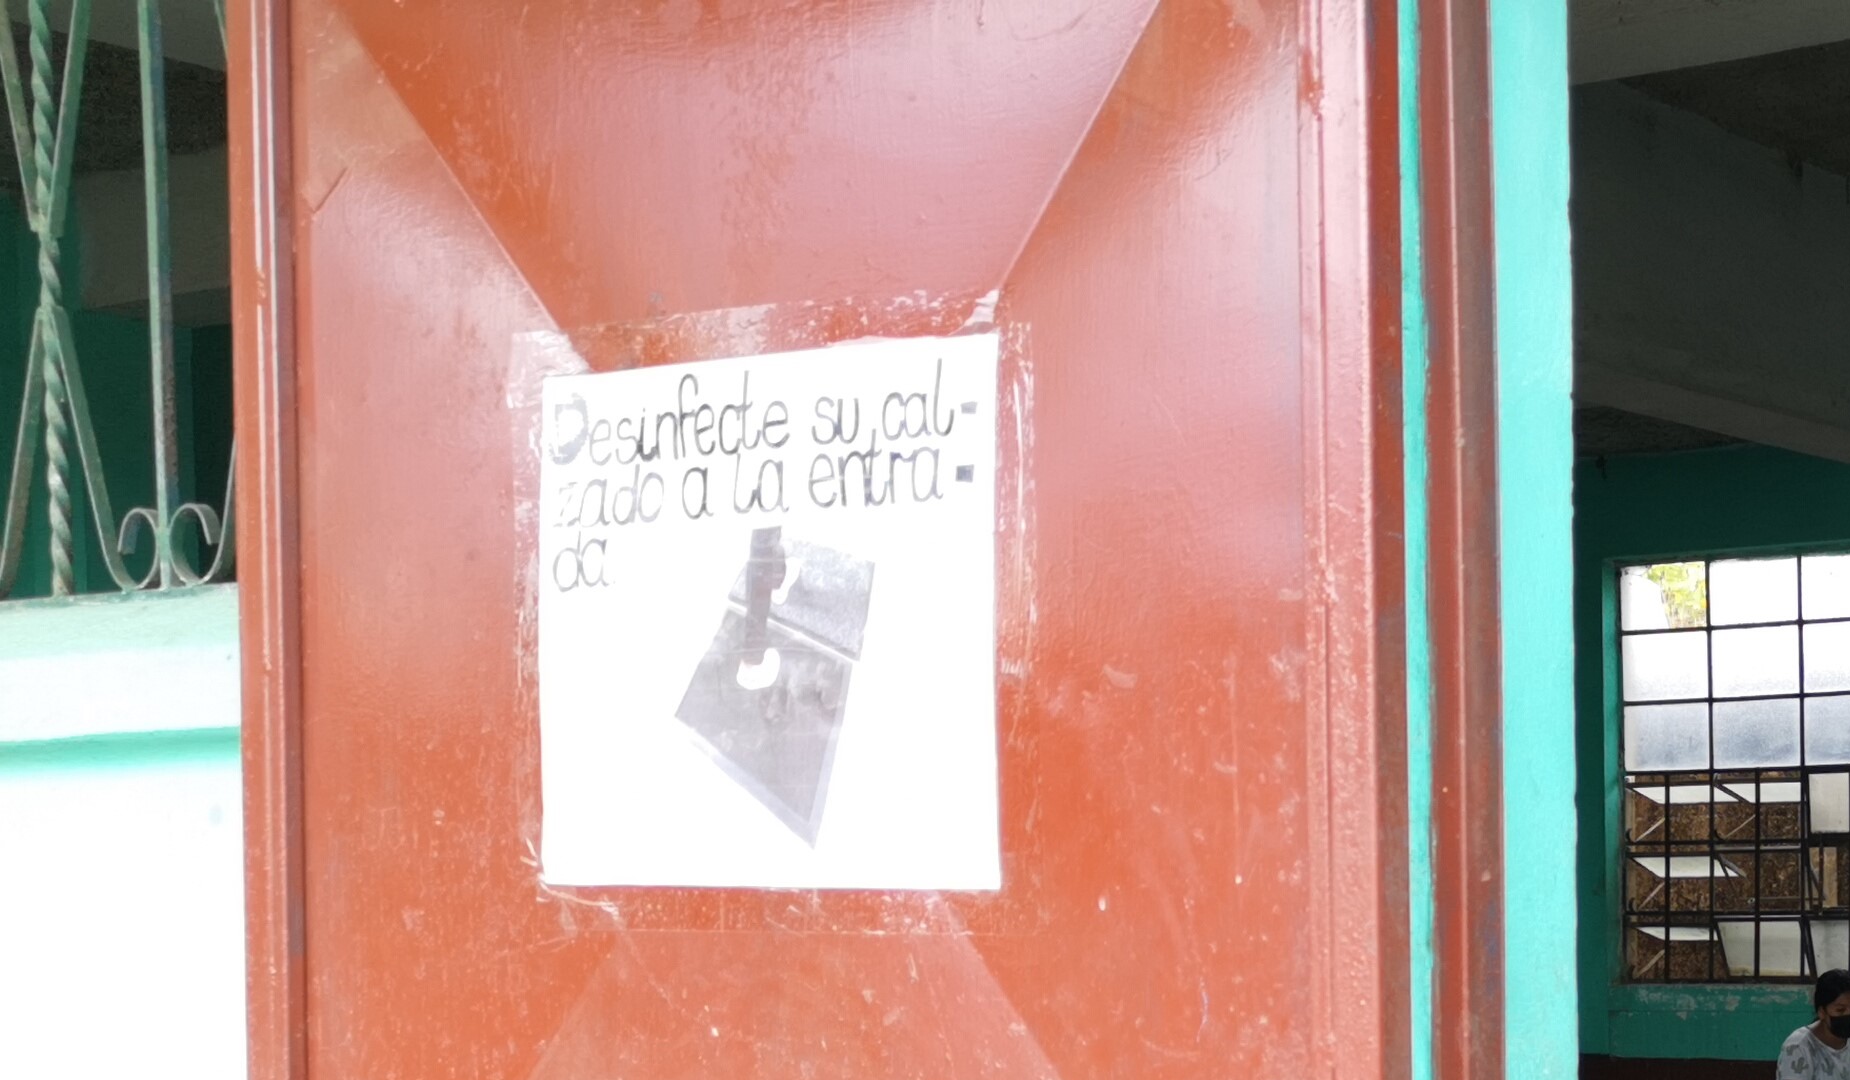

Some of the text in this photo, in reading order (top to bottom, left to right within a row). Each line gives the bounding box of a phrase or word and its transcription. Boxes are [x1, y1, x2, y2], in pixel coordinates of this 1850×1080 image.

[549, 371, 790, 465] Desinfecte
[812, 396, 860, 445] su
[553, 464, 665, 527] zado
[682, 467, 714, 520] a
[733, 453, 789, 514] la
